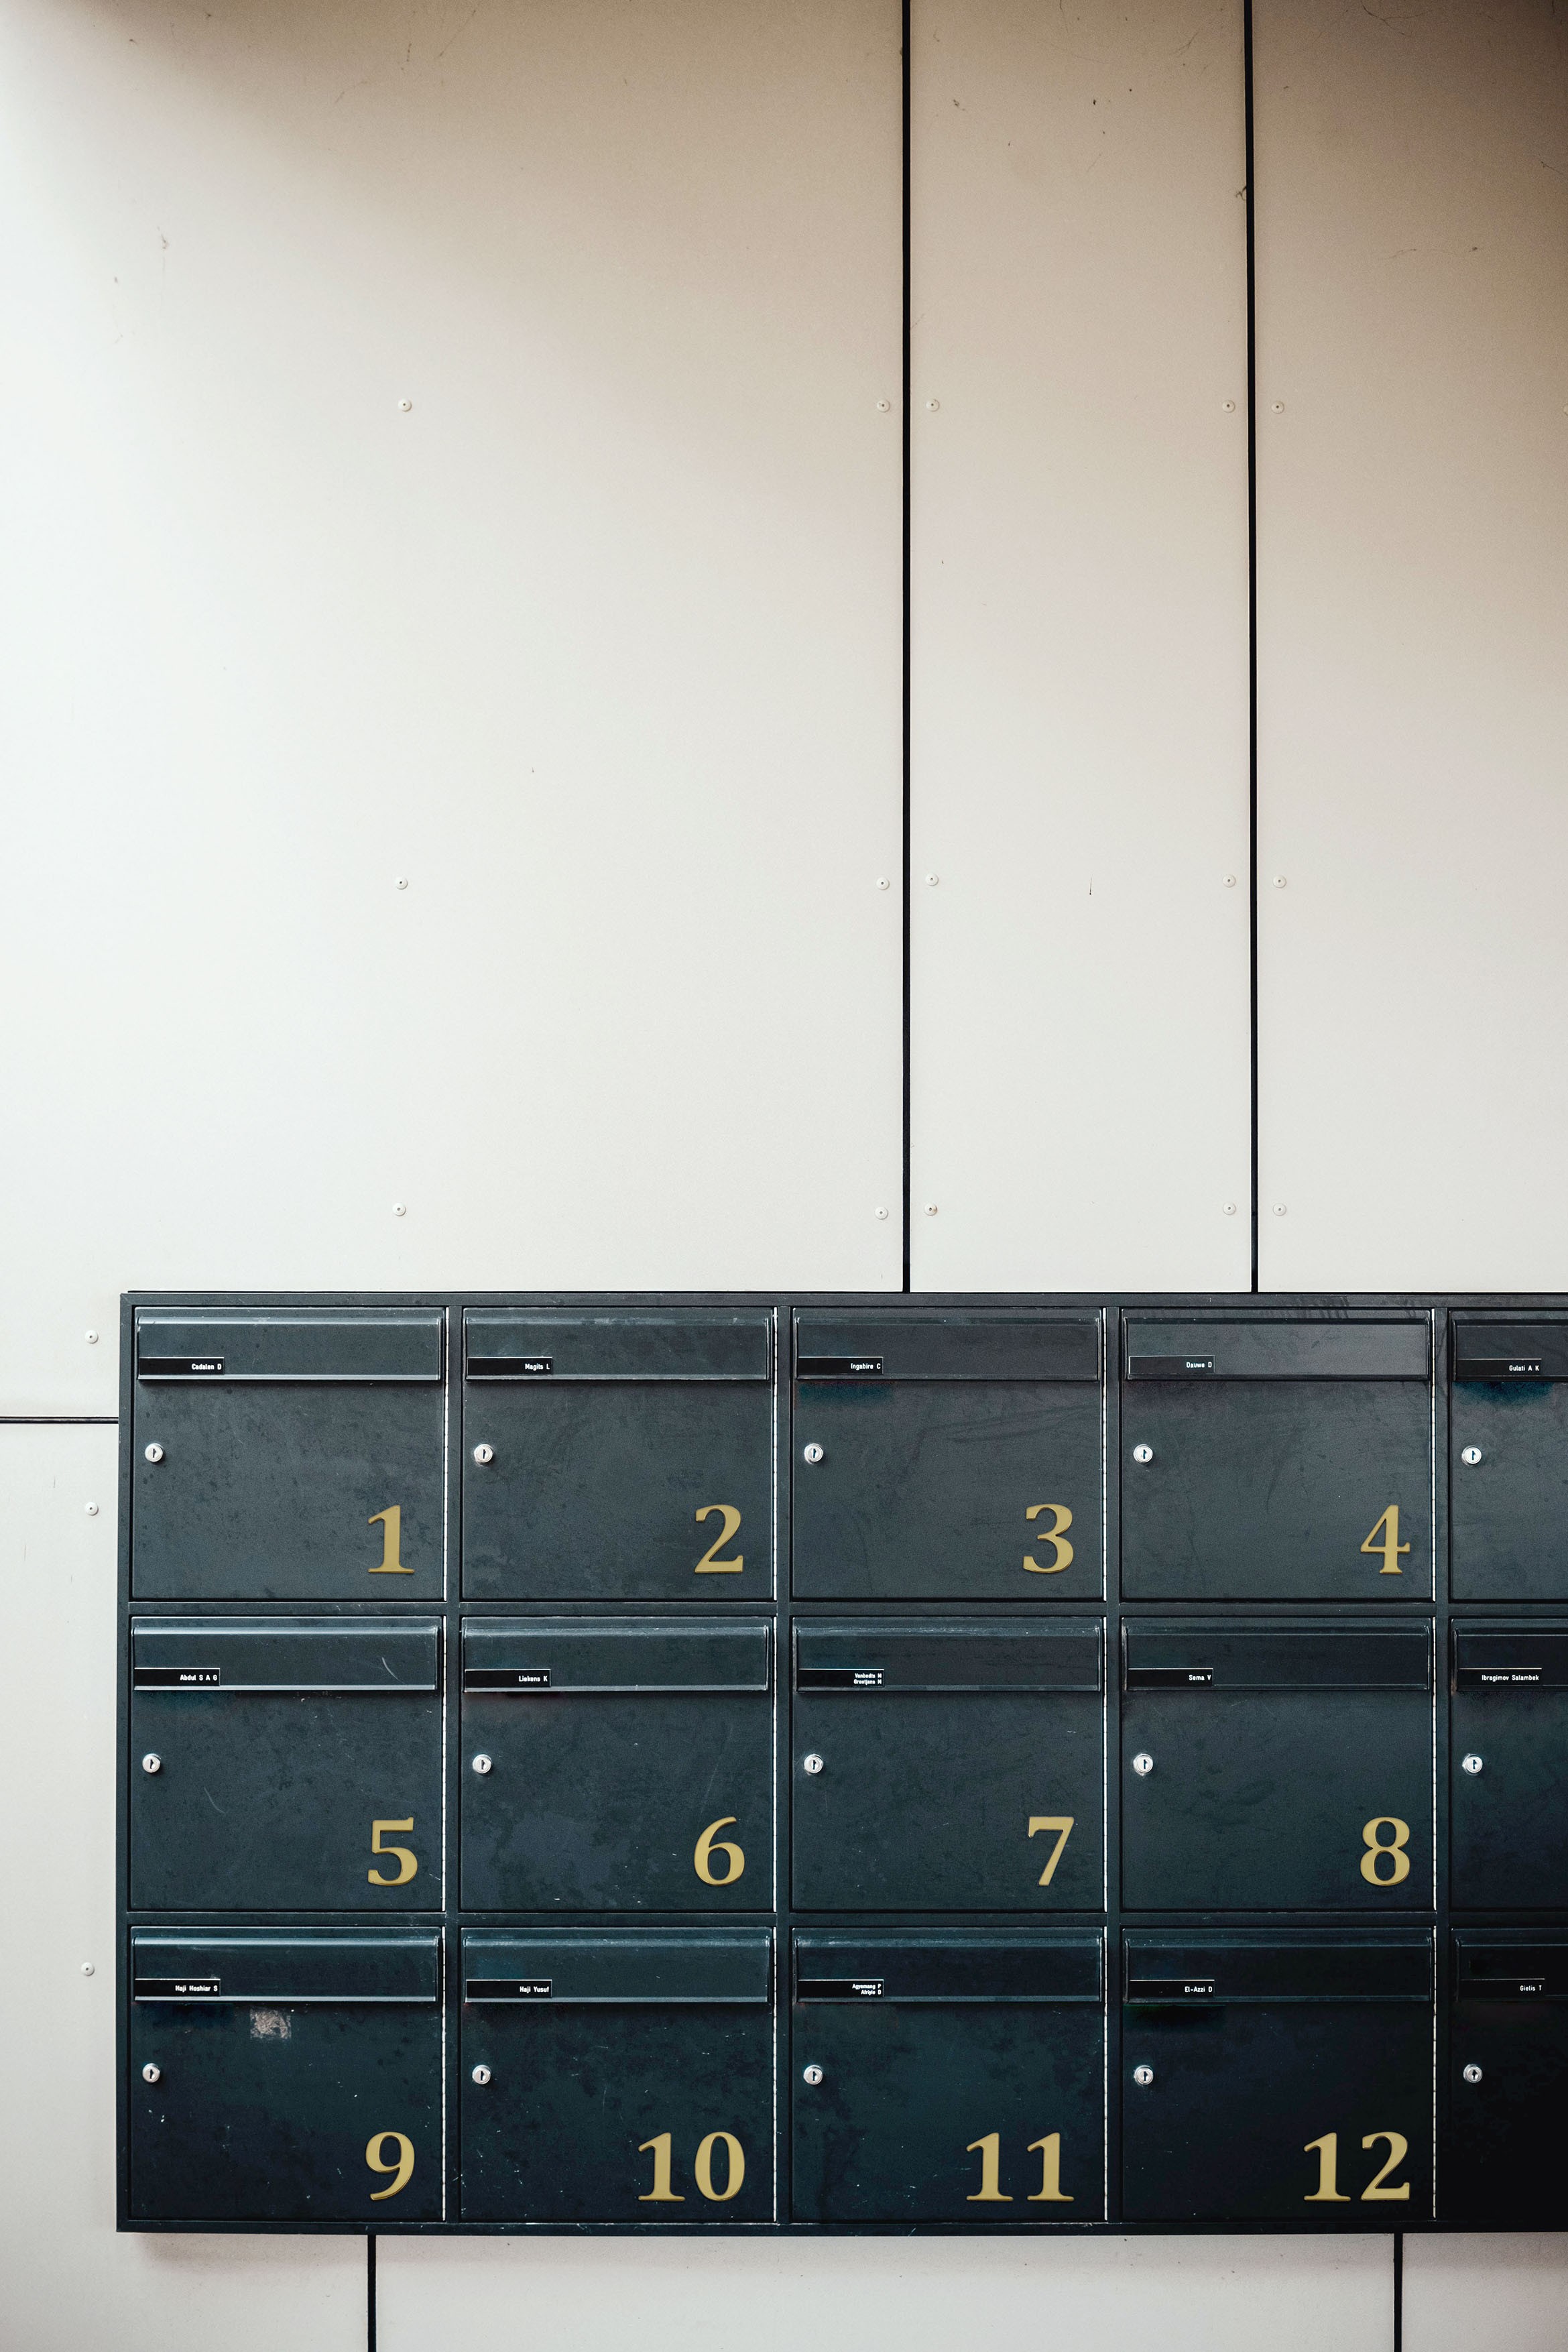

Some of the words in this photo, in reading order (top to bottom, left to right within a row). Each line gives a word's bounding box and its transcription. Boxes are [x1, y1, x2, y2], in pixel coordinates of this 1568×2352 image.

[524, 1362, 544, 1372] Magits
[850, 1362, 874, 1371] Ingabire
[368, 1505, 414, 1574] 1
[695, 1505, 743, 1573] 2
[1023, 1504, 1073, 1573] 3
[1361, 1505, 1410, 1574] 4
[1482, 1674, 1510, 1682] Ibragimov
[368, 1817, 418, 1886] 5
[695, 1817, 744, 1886] 6
[1028, 1817, 1074, 1885] 7
[1361, 1817, 1410, 1886] 8
[175, 1985, 187, 1993] Haji
[519, 1986, 532, 1994] Haji
[366, 2132, 414, 2200] 9
[639, 2132, 745, 2201] 10
[967, 2133, 1073, 2201] 11
[1304, 2132, 1410, 2201] 12
